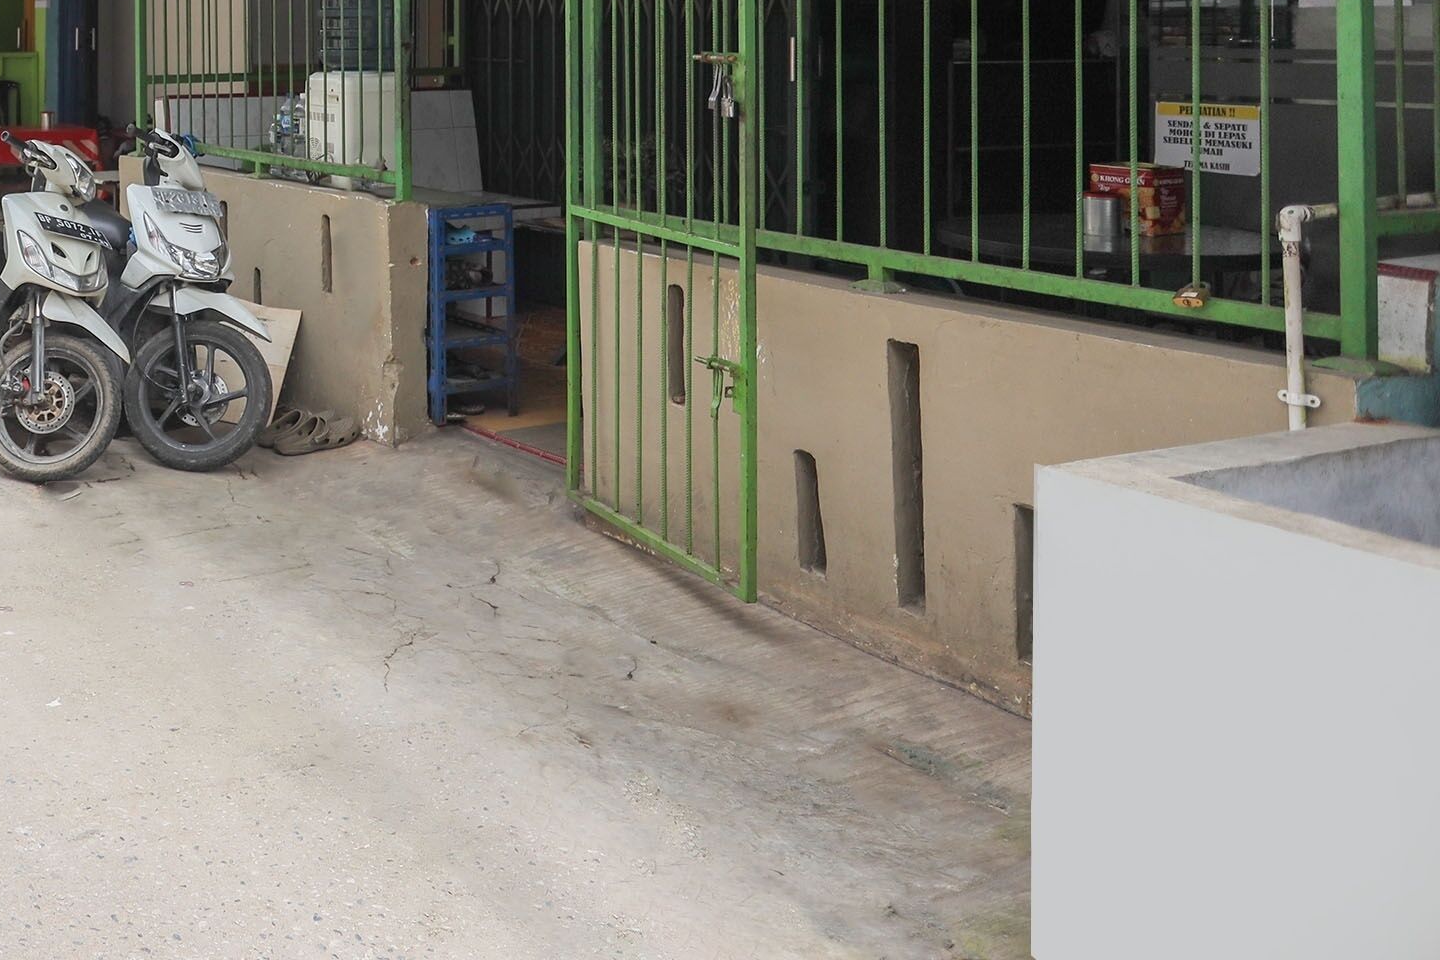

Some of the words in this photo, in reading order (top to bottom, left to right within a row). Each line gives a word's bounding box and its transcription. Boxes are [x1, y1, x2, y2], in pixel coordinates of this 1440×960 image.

[1179, 105, 1227, 118] PEATIAN
[1214, 122, 1248, 132] SEPATU
[1218, 131, 1247, 141] LEPAS
